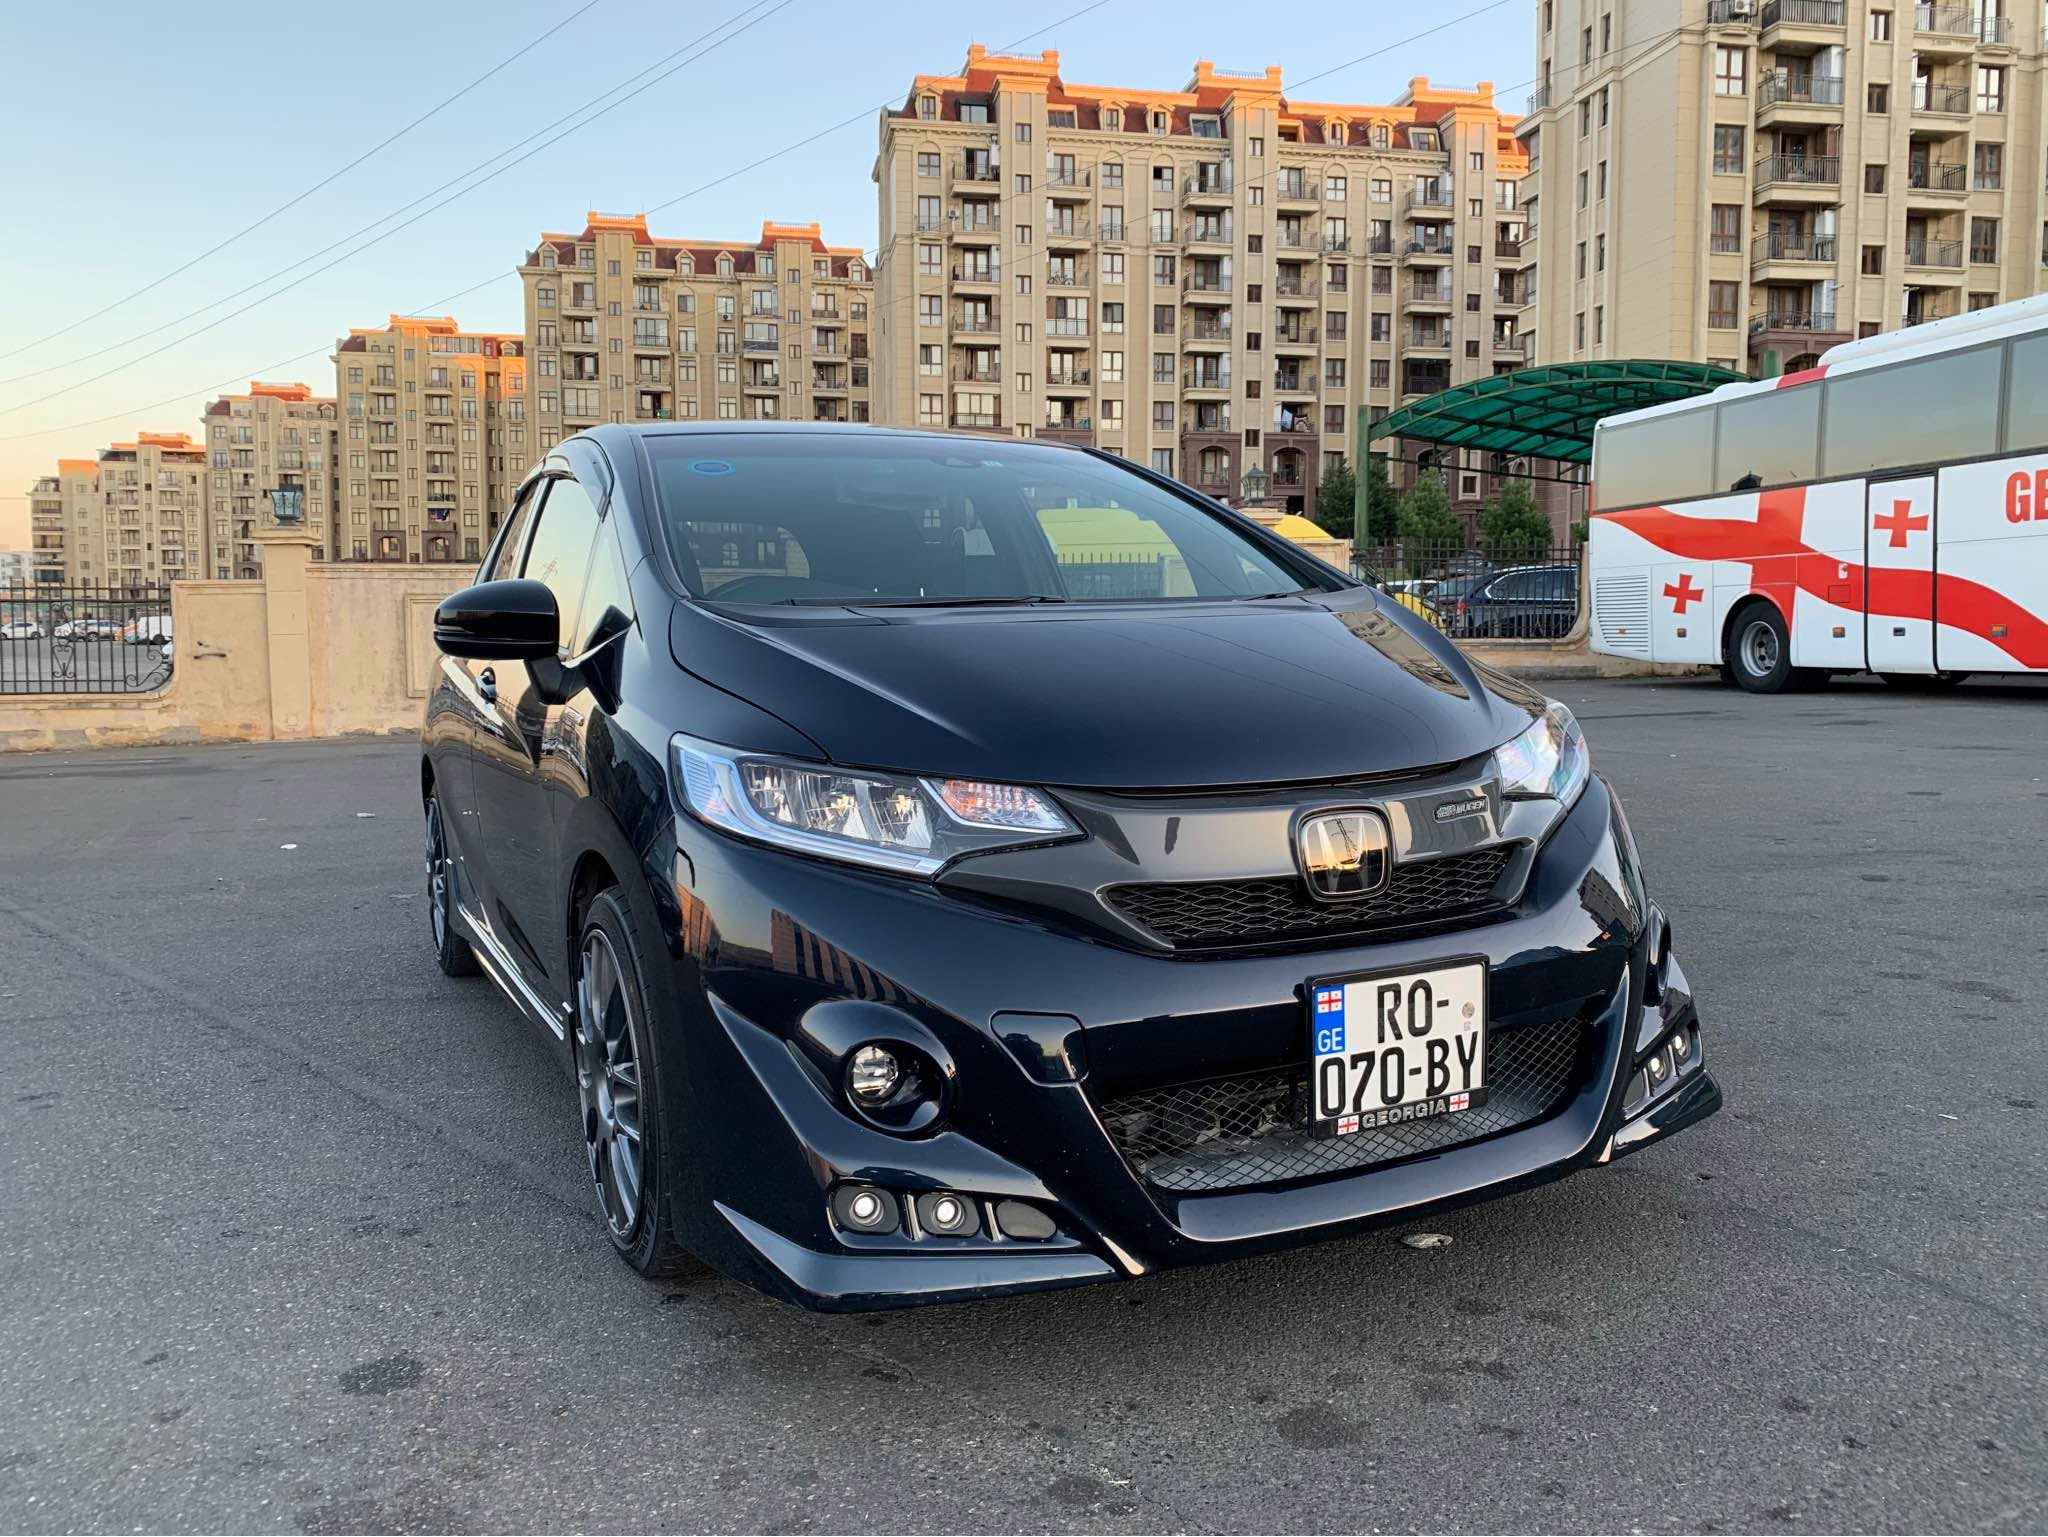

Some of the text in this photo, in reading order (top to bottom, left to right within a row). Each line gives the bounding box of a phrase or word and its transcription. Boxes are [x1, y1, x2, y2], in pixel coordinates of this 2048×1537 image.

[1317, 1027, 1343, 1053] GE
[1319, 1031, 1479, 1118] 070-BY
[1361, 1099, 1447, 1129] GEORGIA
